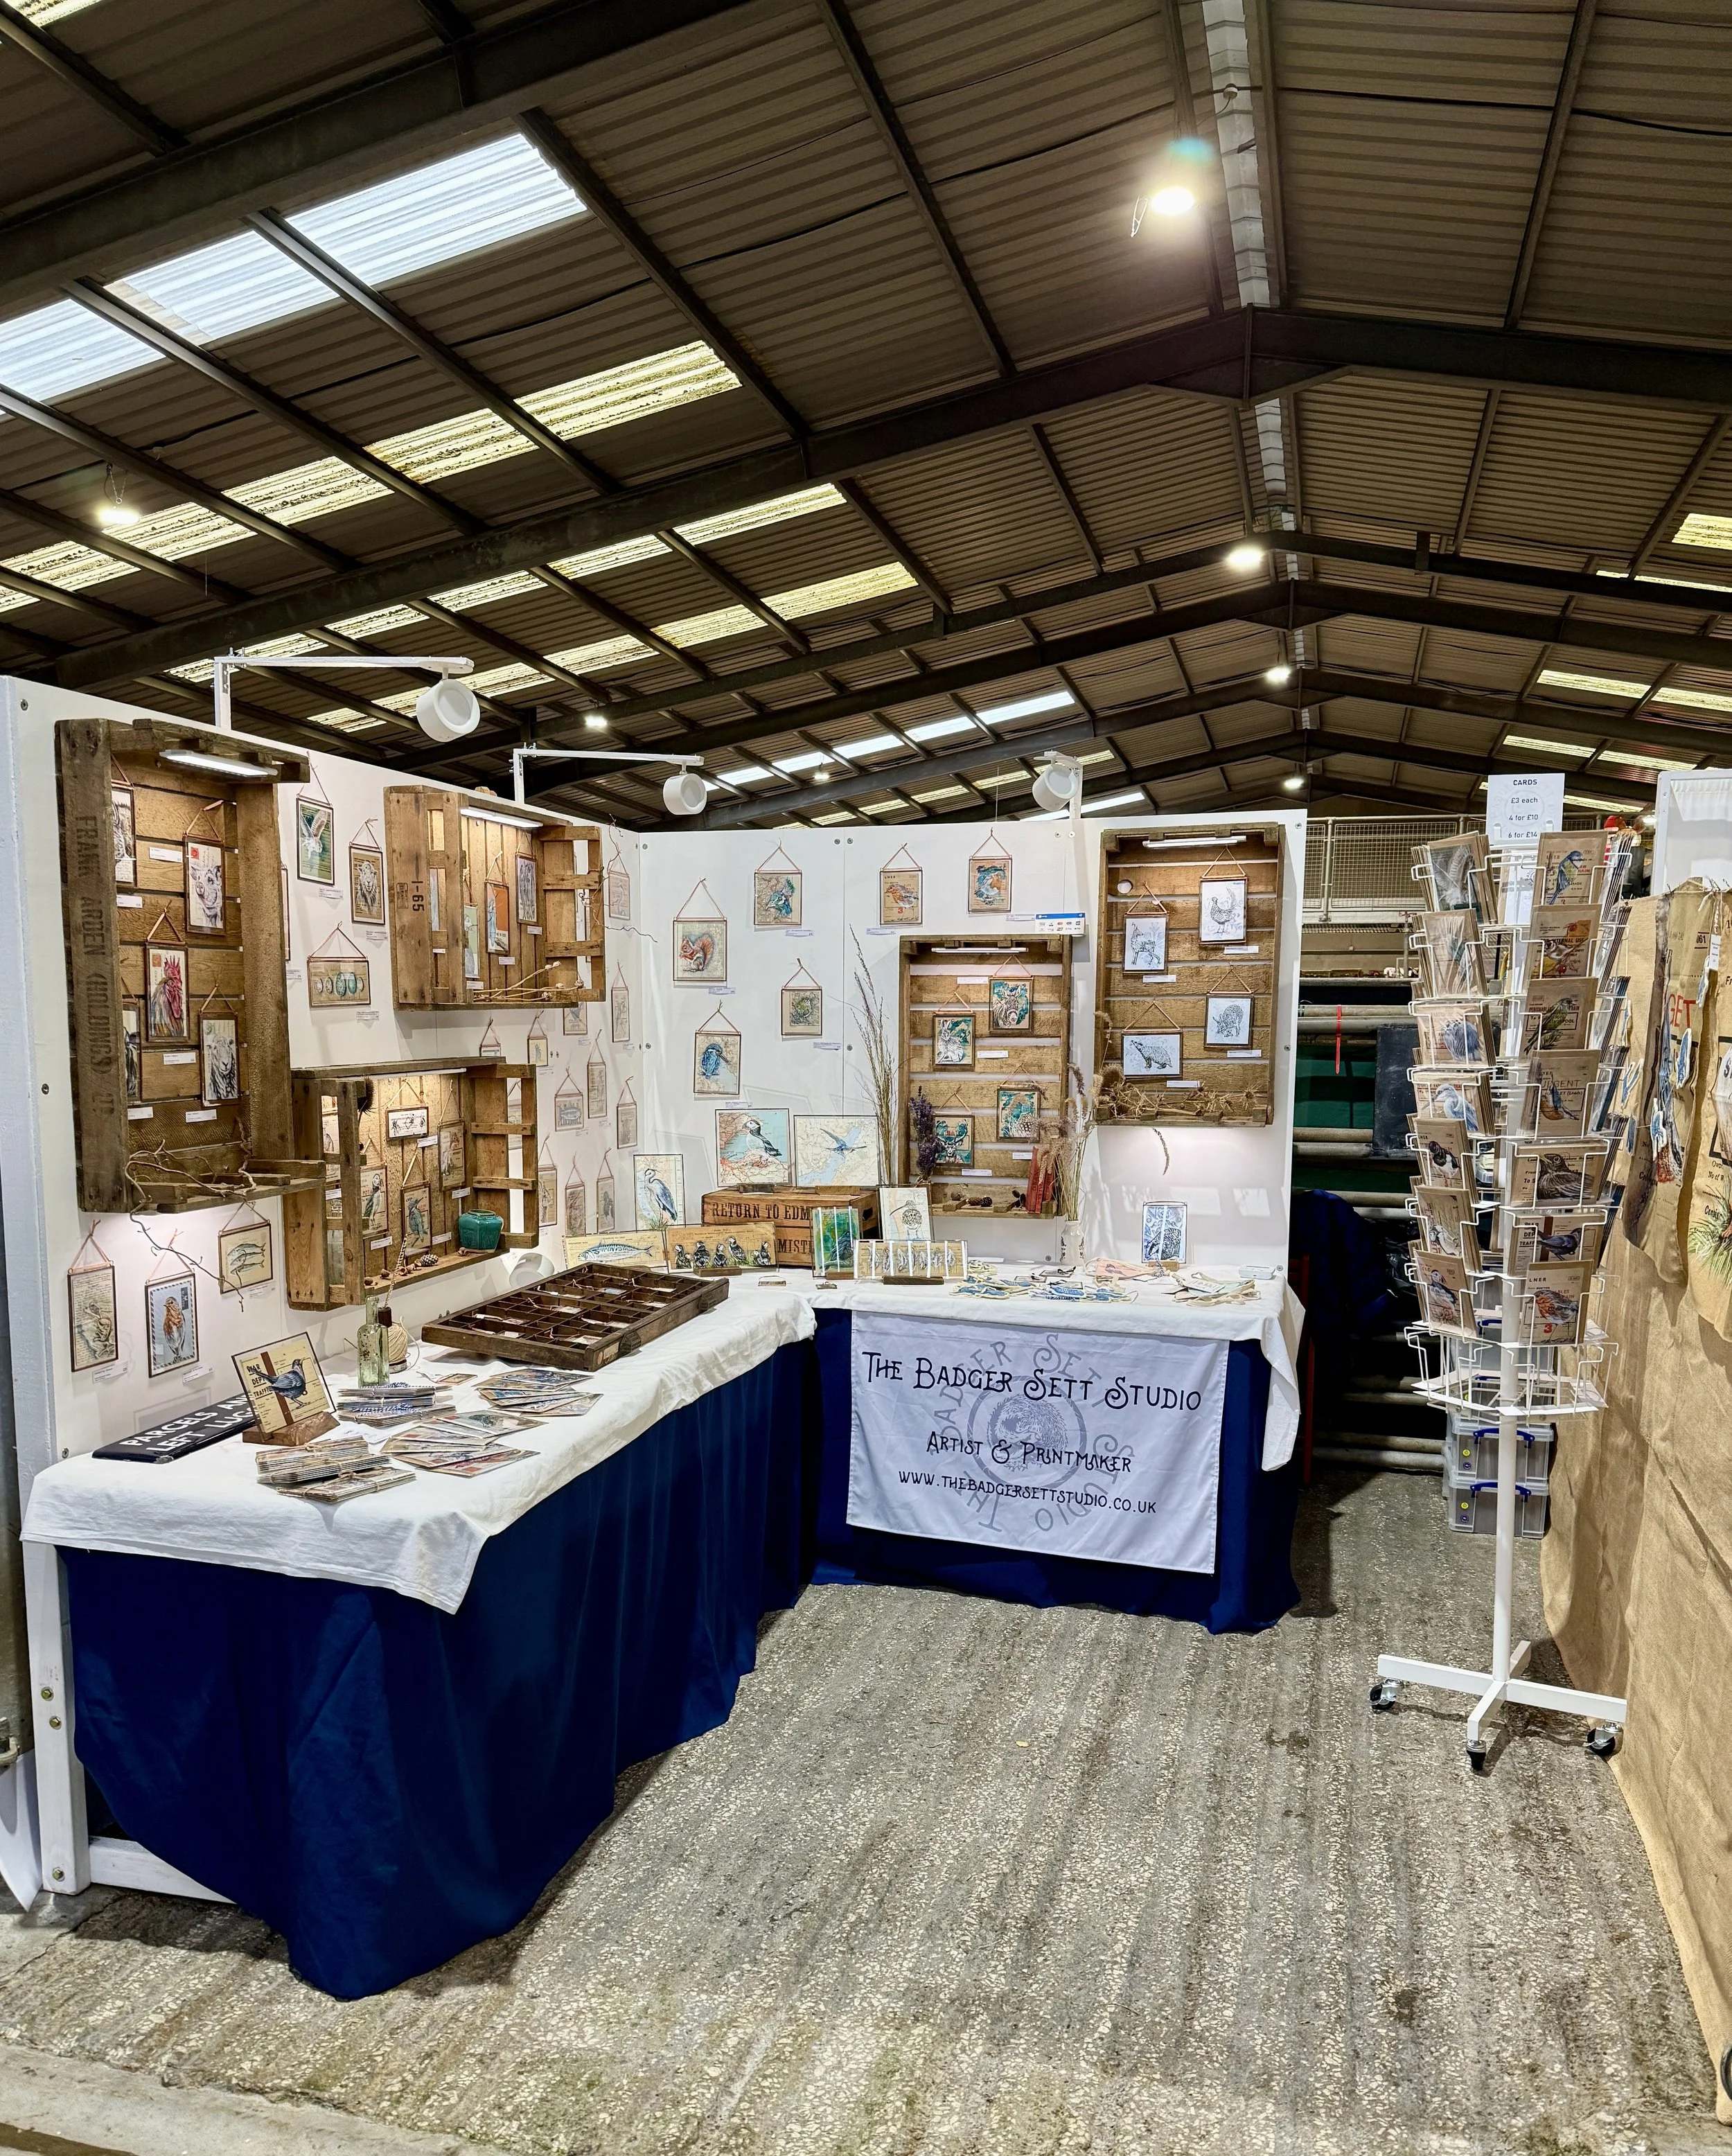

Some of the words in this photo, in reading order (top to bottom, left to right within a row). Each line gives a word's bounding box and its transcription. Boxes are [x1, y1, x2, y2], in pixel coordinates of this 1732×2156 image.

[712, 1202, 760, 1219] RETURN
[766, 1203, 779, 1219] TO
[784, 1205, 812, 1221] EDM
[1544, 1323, 1553, 1334] 3
[862, 1351, 903, 1383] THE
[912, 1357, 1013, 1393] BADGER
[1023, 1368, 1093, 1402] SETT
[1104, 1376, 1201, 1411] STUDIO
[119, 1411, 218, 1446] PARCELS
[146, 1431, 206, 1451] LEFT
[926, 1431, 984, 1456] ARTIST
[991, 1439, 1012, 1465] &
[1020, 1441, 1131, 1473] PRINTMAKER
